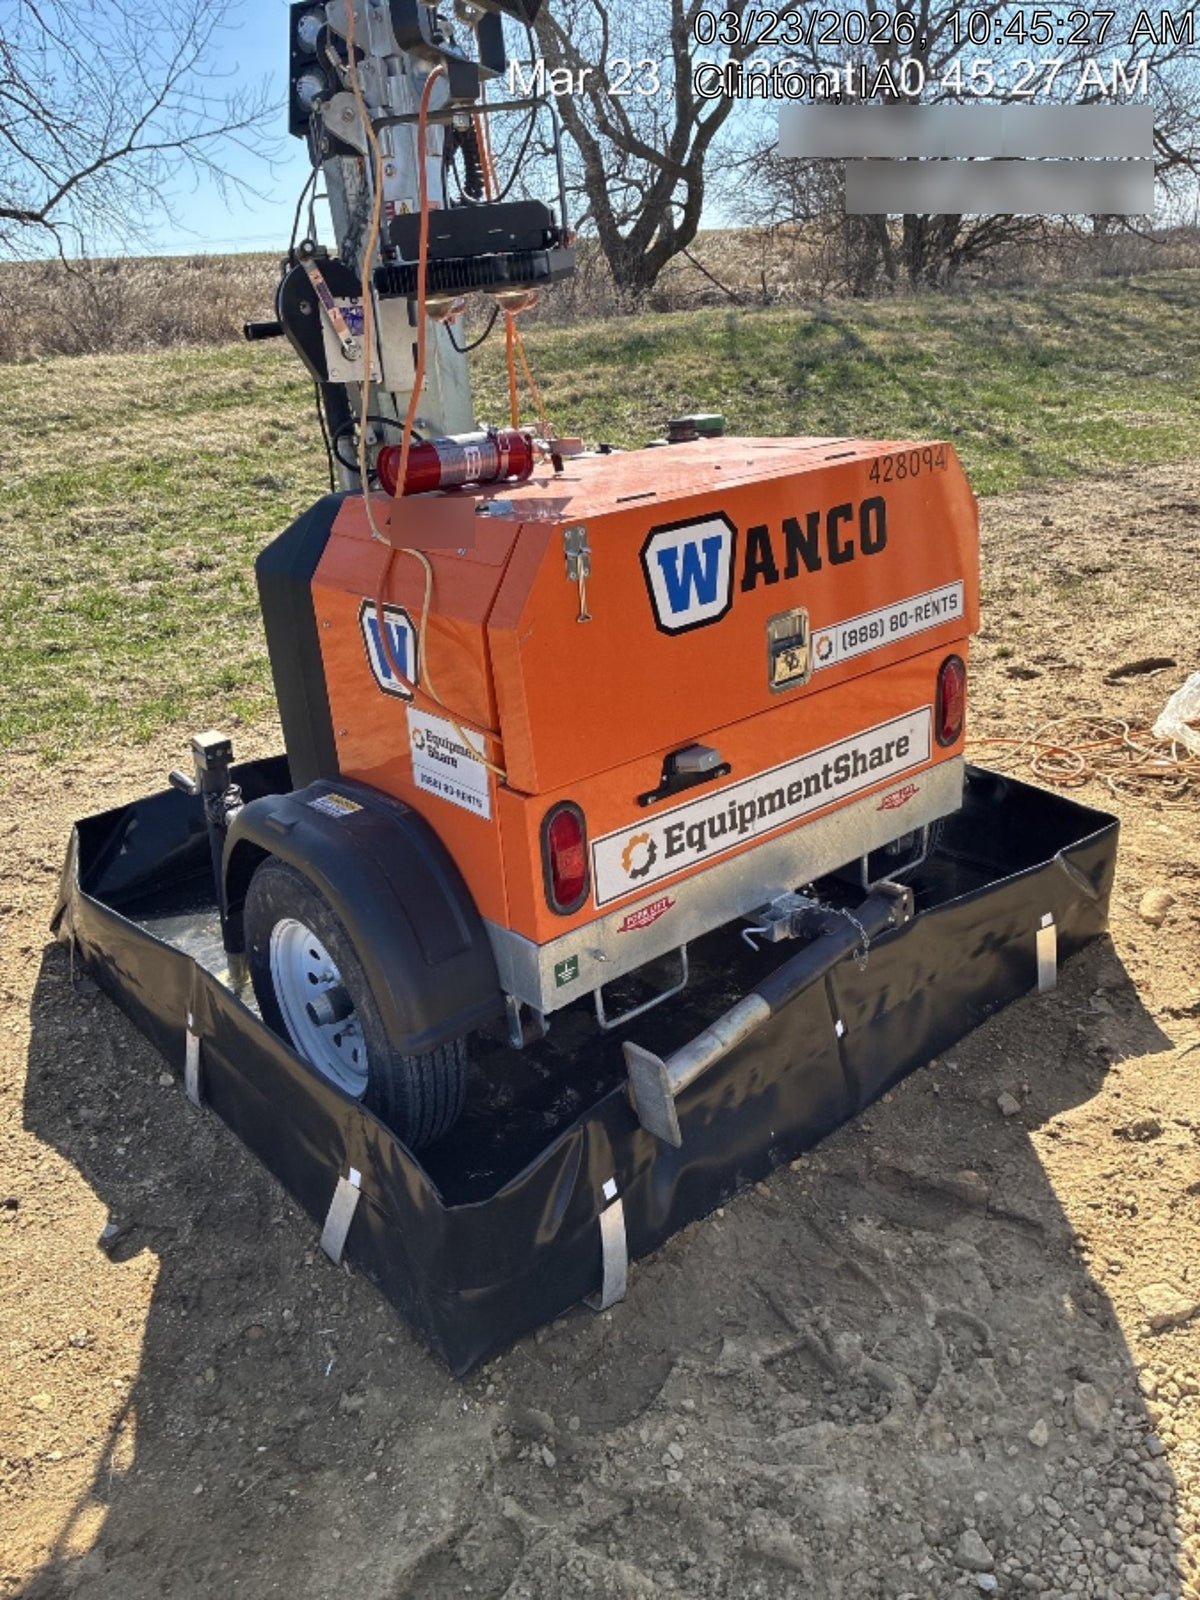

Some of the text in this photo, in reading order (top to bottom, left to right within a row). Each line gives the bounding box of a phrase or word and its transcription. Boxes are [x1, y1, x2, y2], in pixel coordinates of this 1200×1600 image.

[868, 447, 949, 485] 428094
[655, 495, 888, 615] WANCO
[842, 592, 959, 652] (888) 80-RENTS
[663, 733, 911, 860] EquipmentShare
